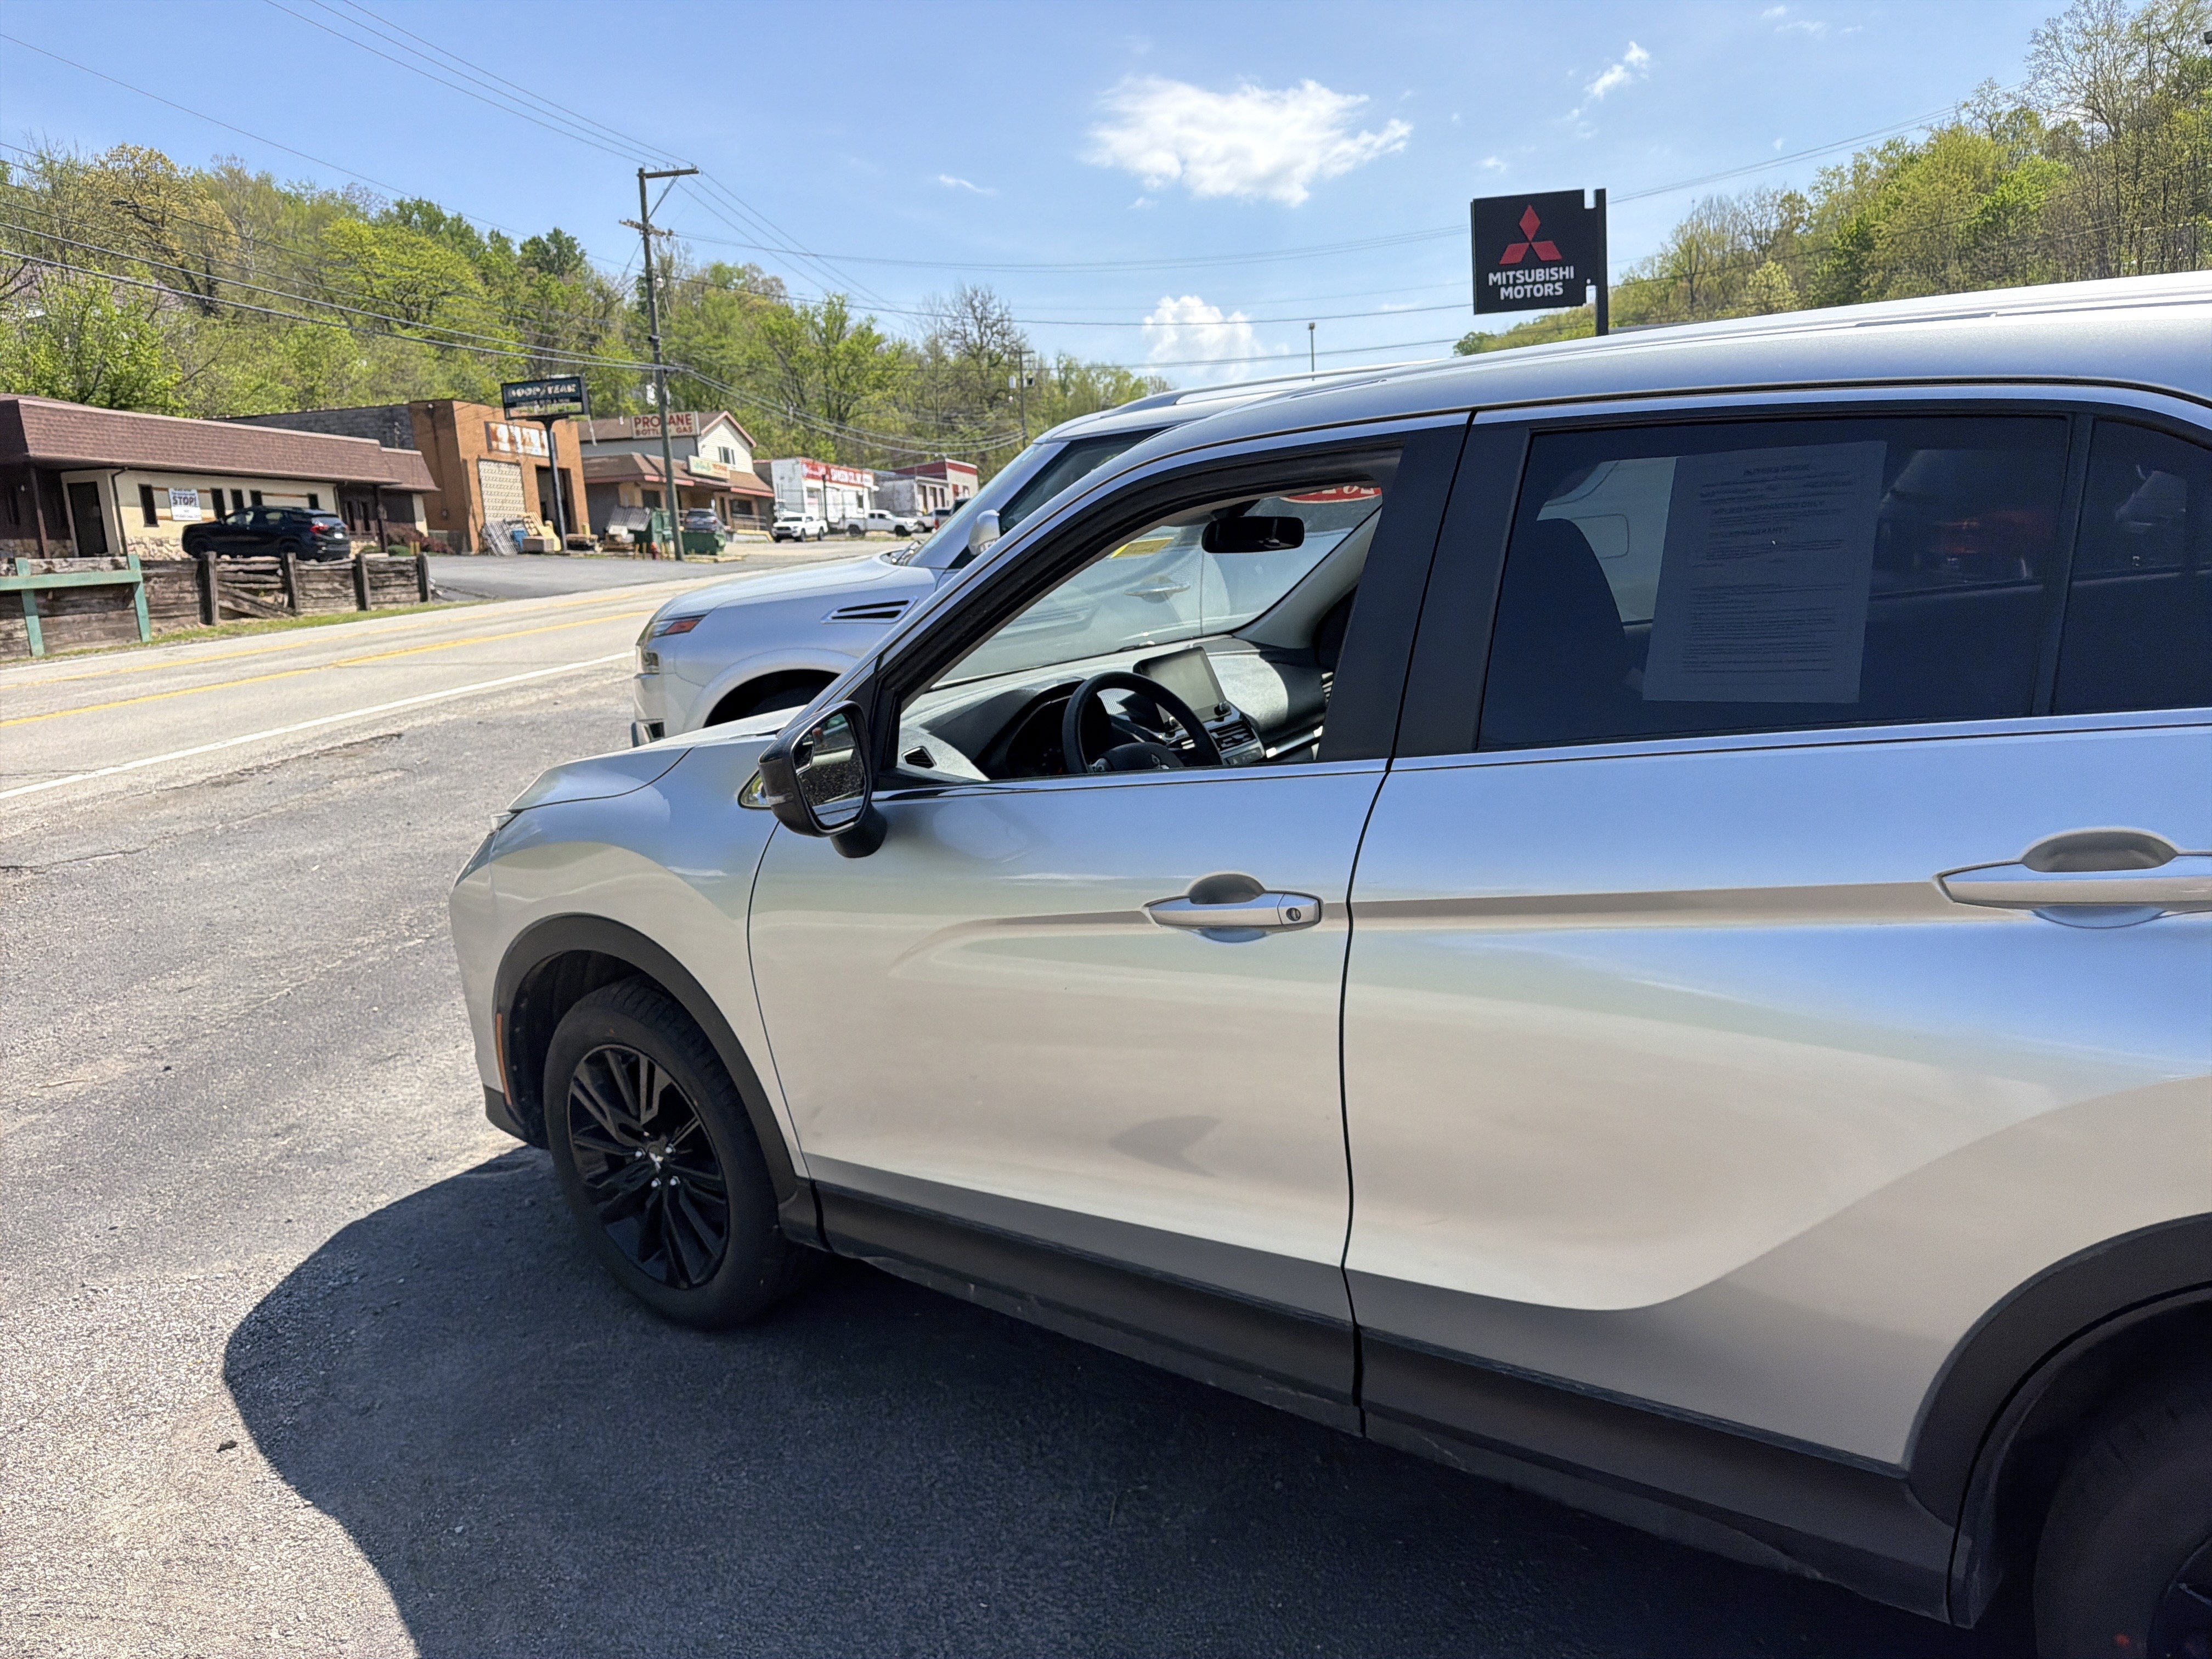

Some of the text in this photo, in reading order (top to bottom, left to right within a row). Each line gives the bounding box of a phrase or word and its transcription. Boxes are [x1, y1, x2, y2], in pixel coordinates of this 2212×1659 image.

[1488, 266, 1575, 286] MITSUBISHI
[1499, 282, 1564, 300] MOTORS
[634, 414, 692, 428] PROANE
